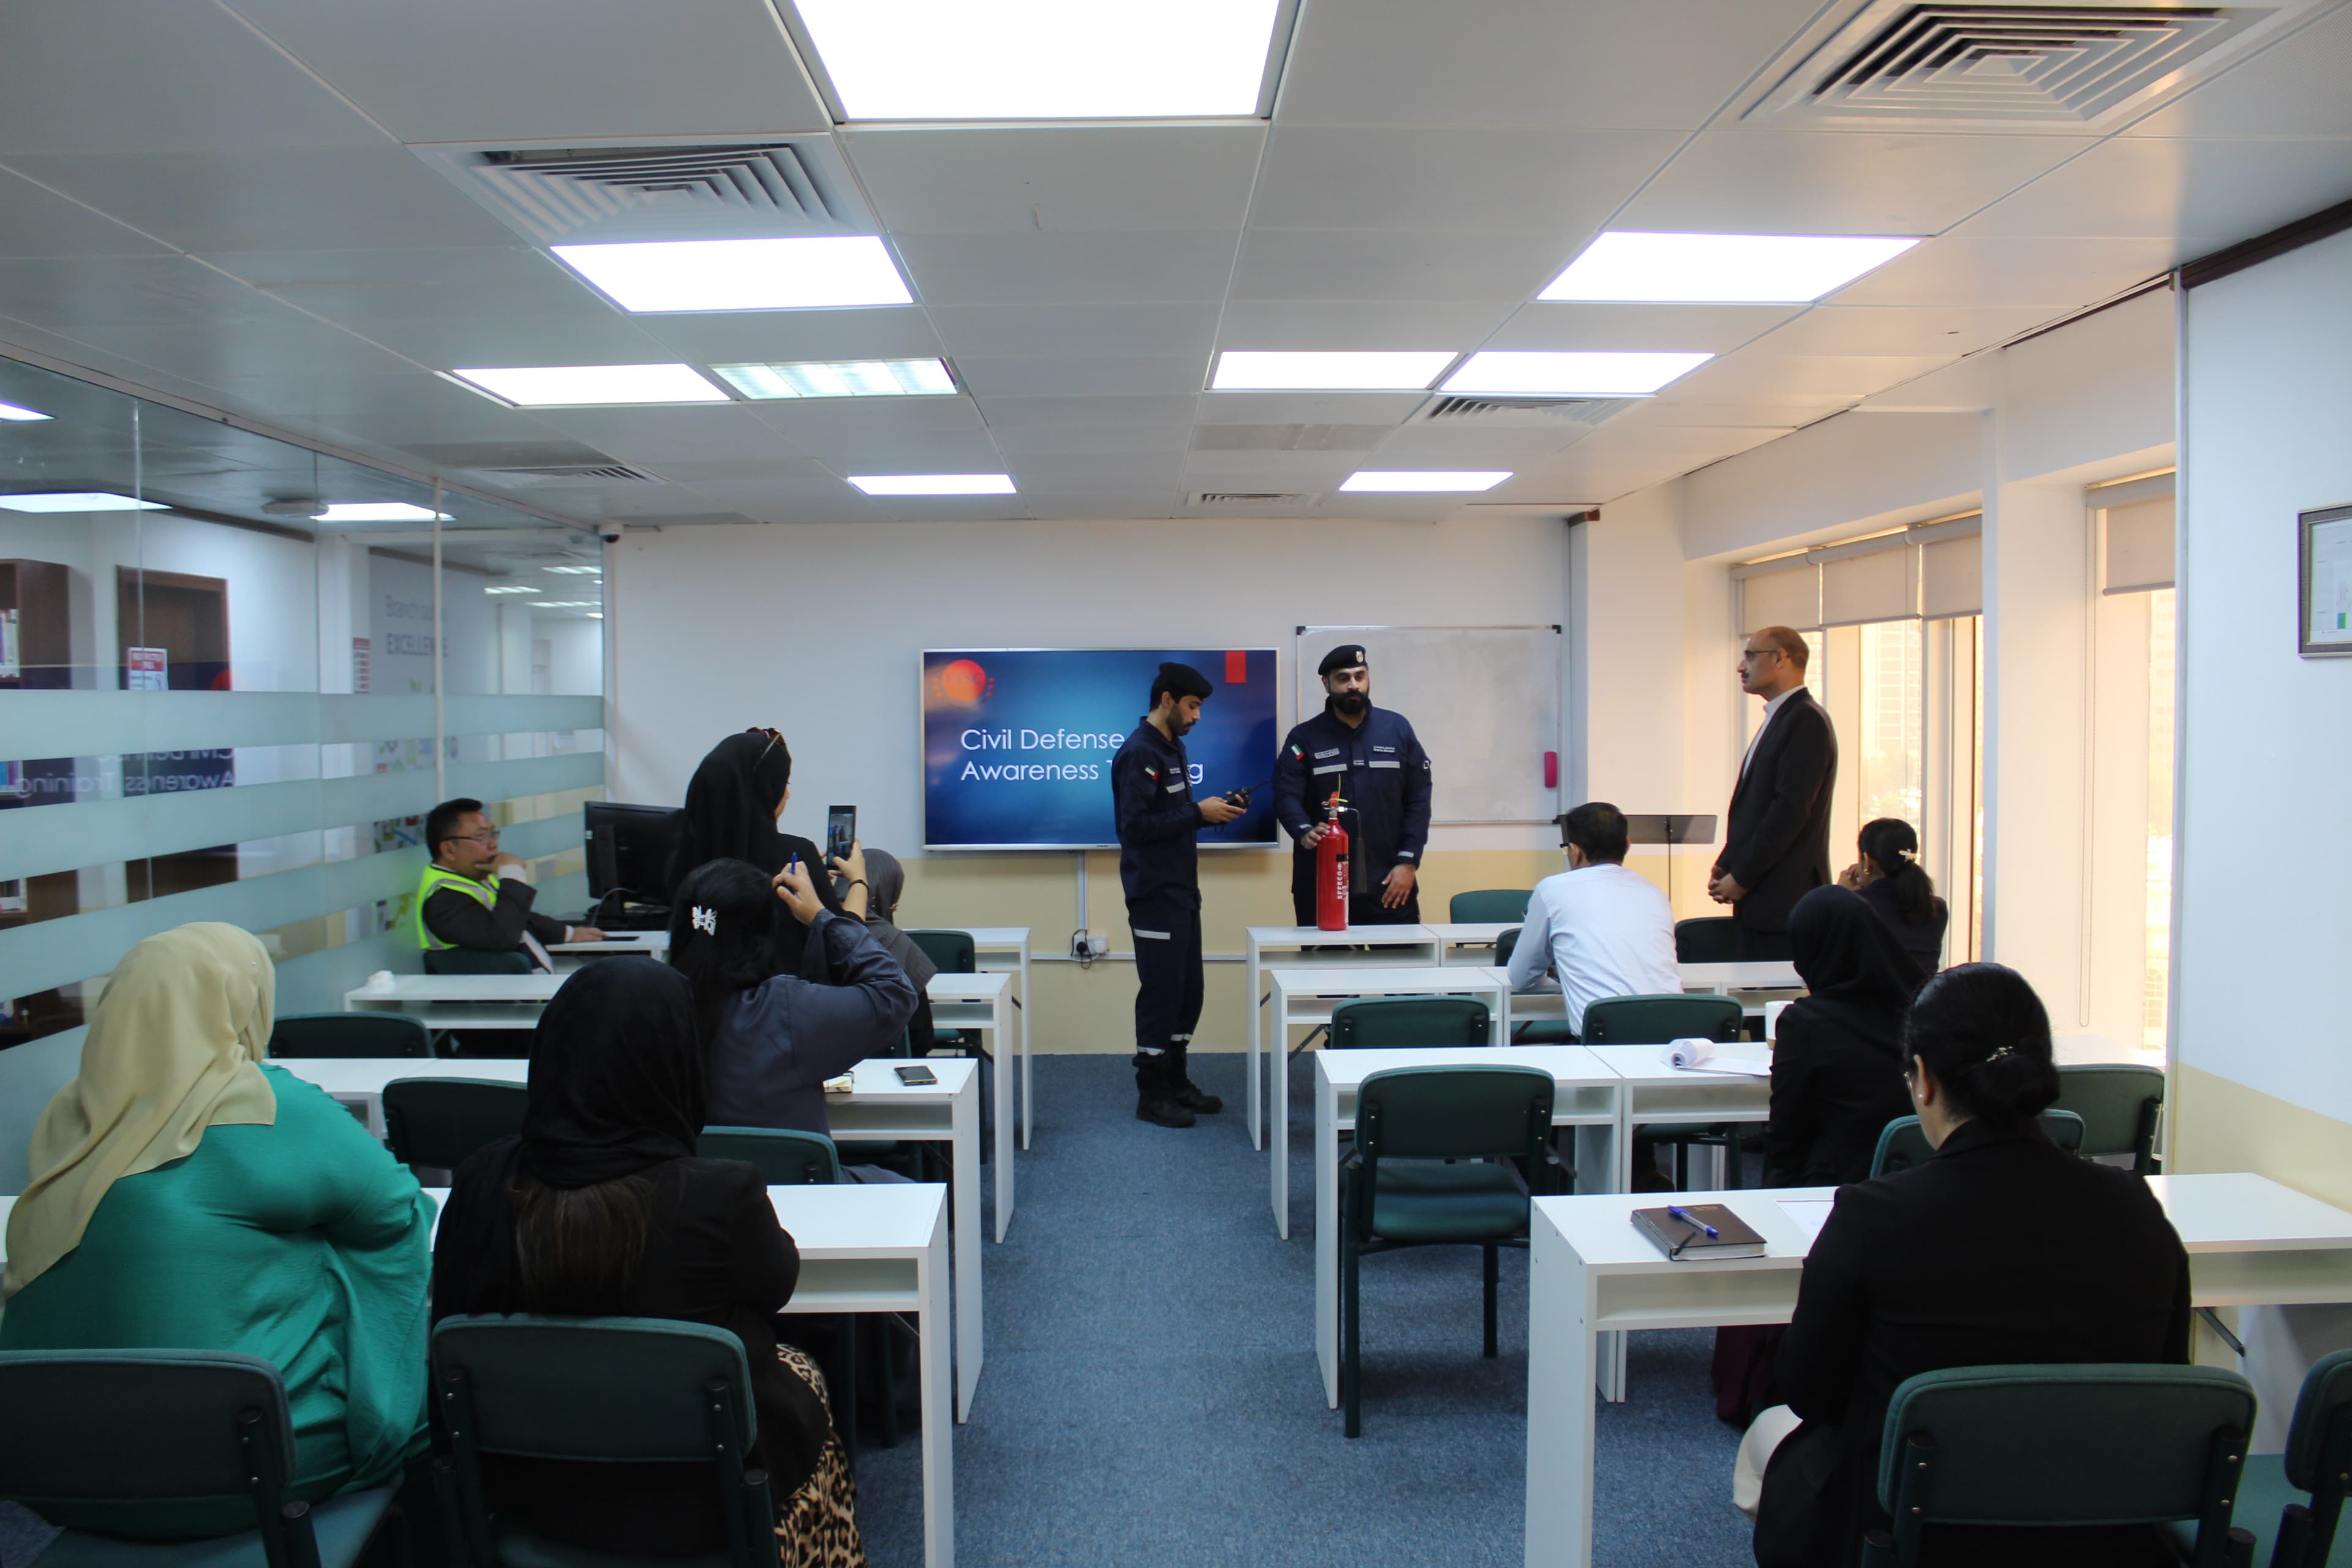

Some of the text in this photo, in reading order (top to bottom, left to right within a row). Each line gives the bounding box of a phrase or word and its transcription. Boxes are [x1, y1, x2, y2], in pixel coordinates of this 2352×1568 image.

[960, 728, 1126, 750] Civil Defense
[960, 760, 1099, 781] Awareness
